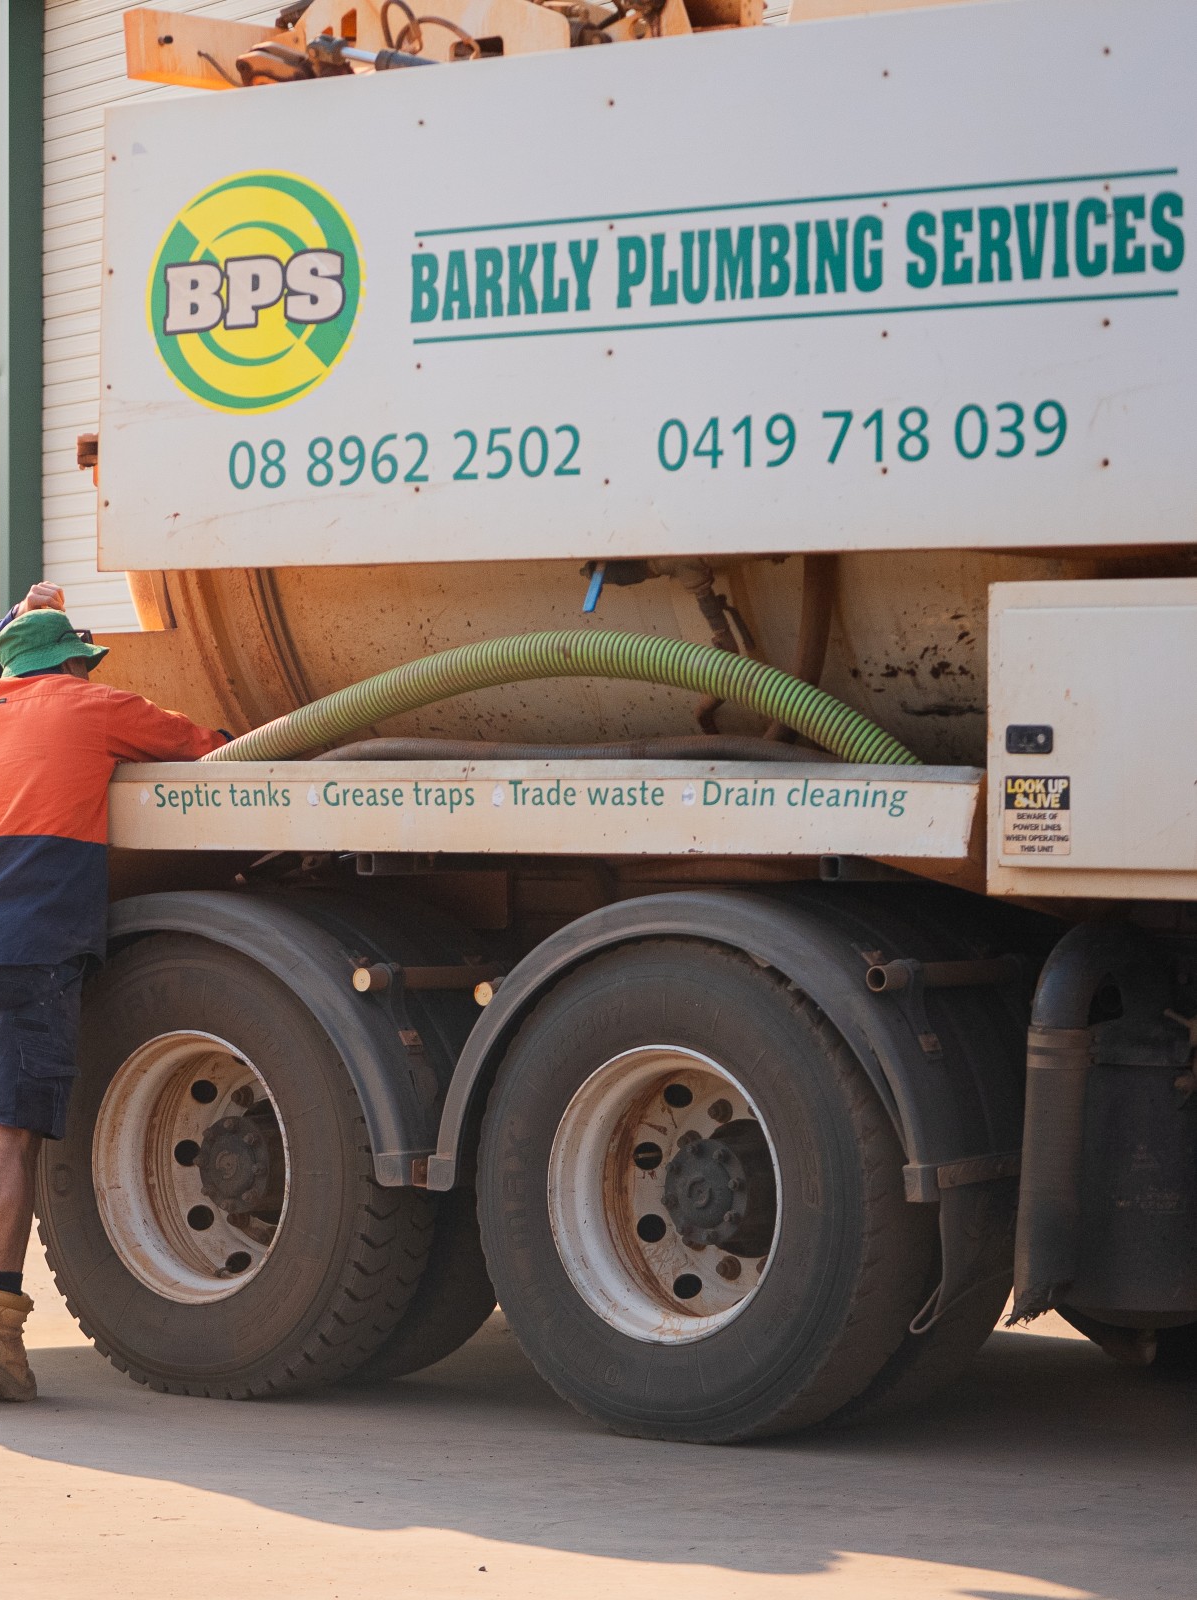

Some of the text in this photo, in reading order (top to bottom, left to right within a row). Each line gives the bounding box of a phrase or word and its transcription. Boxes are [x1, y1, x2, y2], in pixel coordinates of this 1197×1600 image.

[410, 190, 1186, 323] BARKLY PLUMBING SERVICES
[163, 247, 347, 336] BPS
[657, 399, 1068, 472] 0419 718 039
[228, 424, 582, 490] 08 8962 2502
[155, 782, 291, 814] Septic tanks
[322, 781, 475, 813] Grease traps
[508, 779, 665, 806] Trade waste
[702, 778, 909, 817] Drain cleaning
[1007, 779, 1068, 793] LOOK UP
[1012, 823, 1062, 831] POWER LINES
[1016, 812, 1058, 820] BEWARE OF
[1005, 834, 1069, 842] WHEN OPERATING
[1020, 845, 1054, 853] THIS UNIT
